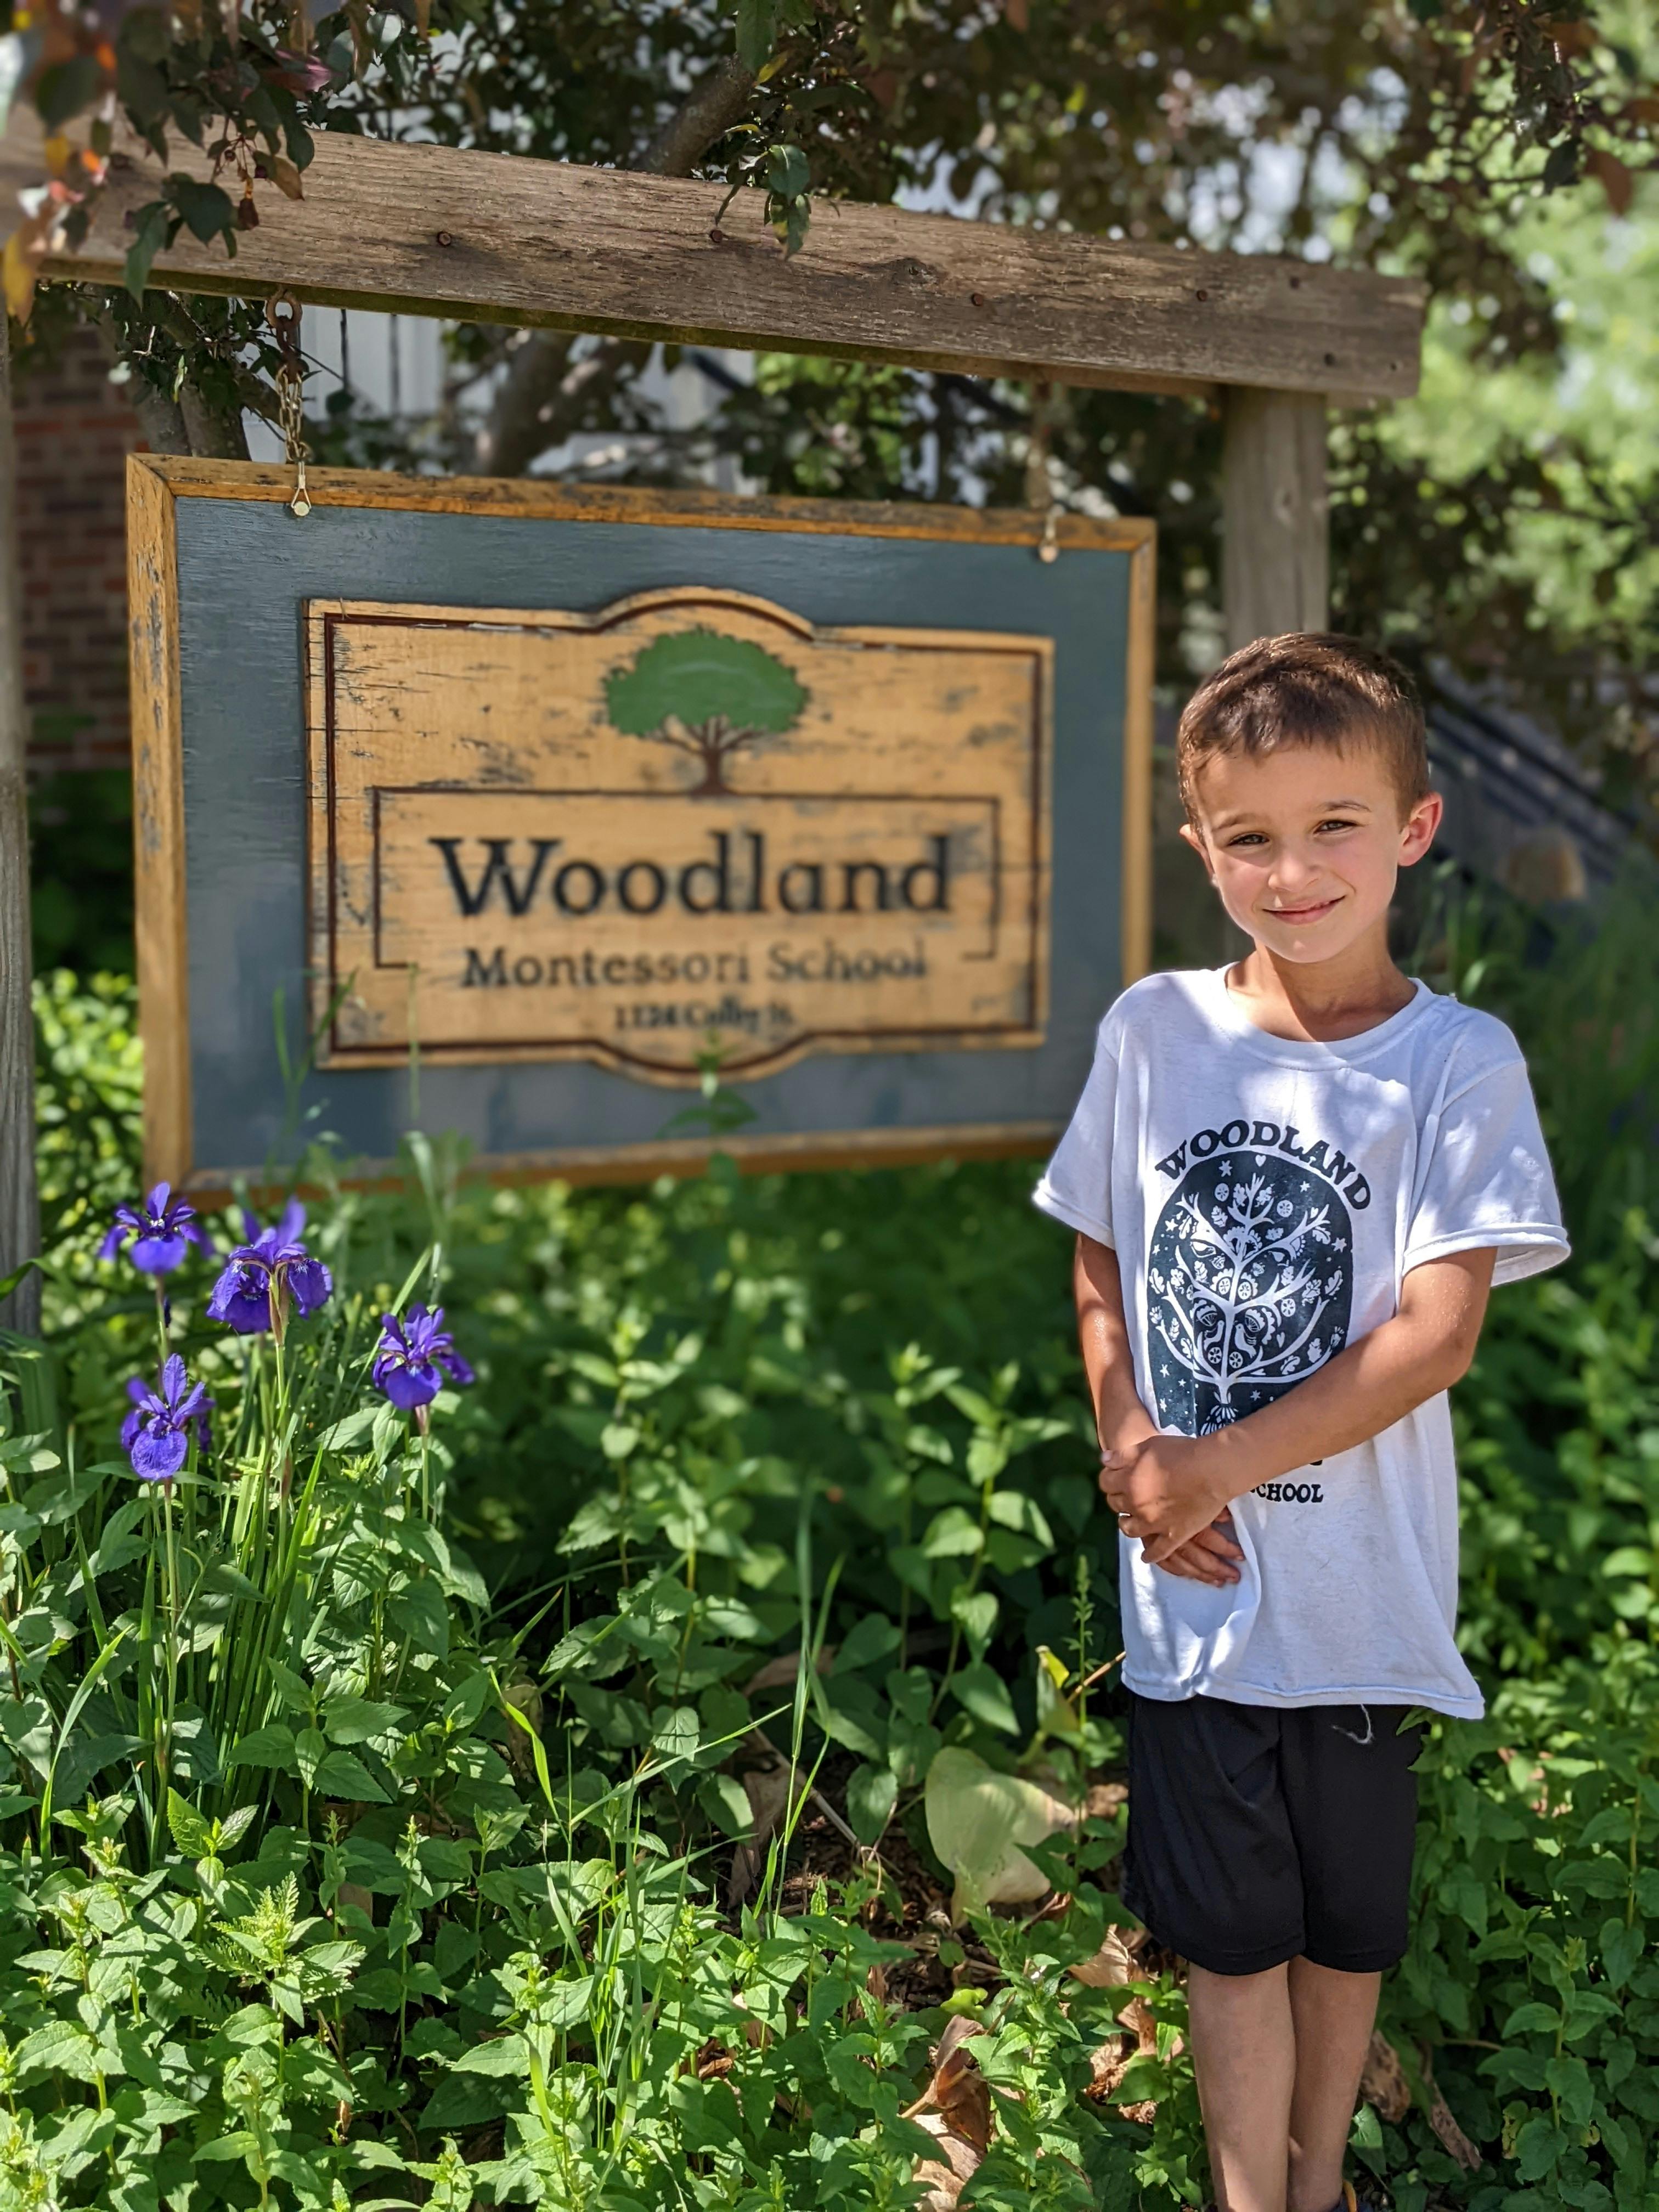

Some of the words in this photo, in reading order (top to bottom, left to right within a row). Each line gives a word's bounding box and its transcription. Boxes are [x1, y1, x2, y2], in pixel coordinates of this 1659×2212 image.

[428, 830, 955, 918] Woodland
[462, 946, 752, 988] Montessori
[767, 935, 929, 981] School
[1155, 1119, 1371, 1210] WOODLAND
[1250, 1483, 1324, 1503] CHOOL
